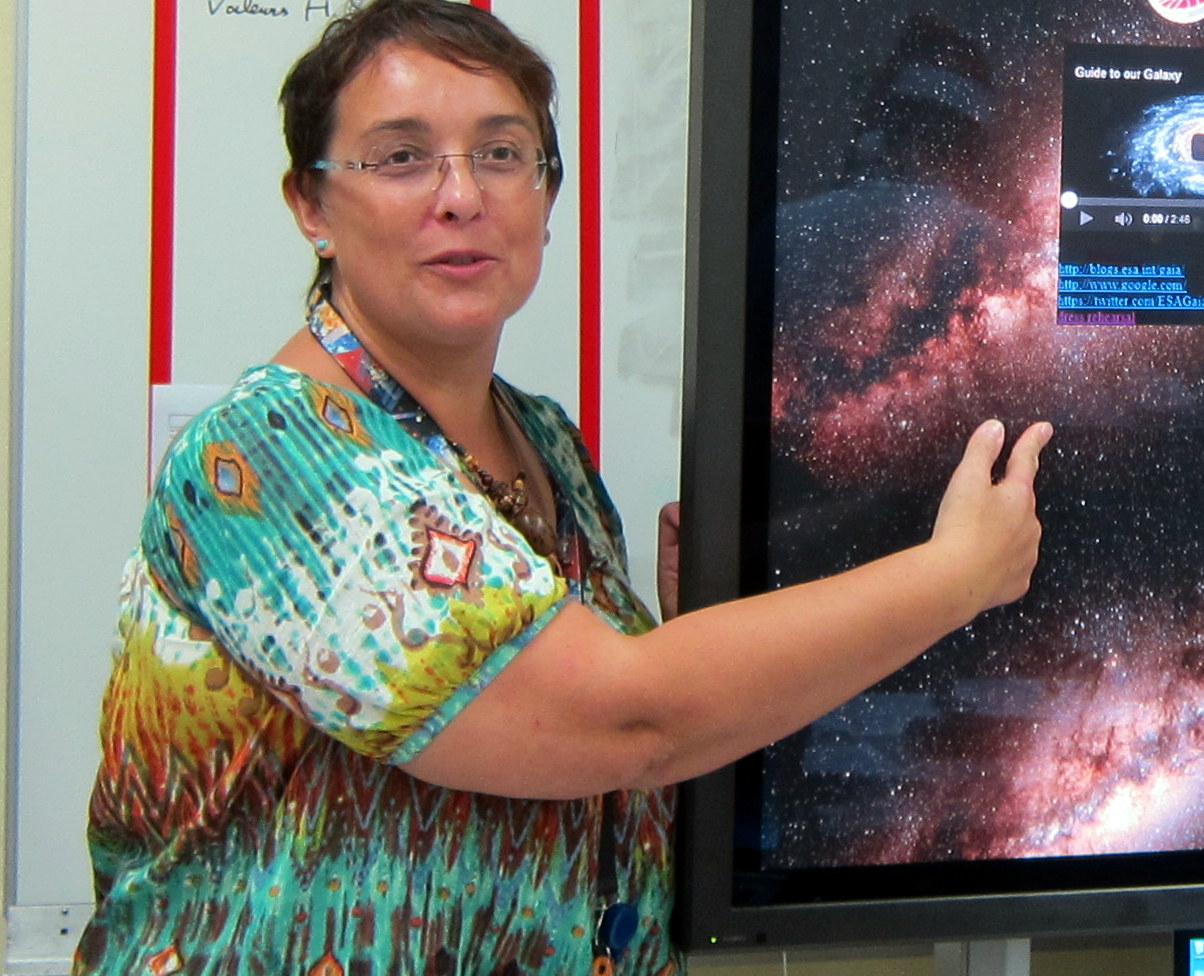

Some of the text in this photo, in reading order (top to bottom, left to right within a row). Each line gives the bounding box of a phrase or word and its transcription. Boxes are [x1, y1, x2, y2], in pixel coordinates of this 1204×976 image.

[1074, 66, 1183, 85] Guide to our Galaxy
